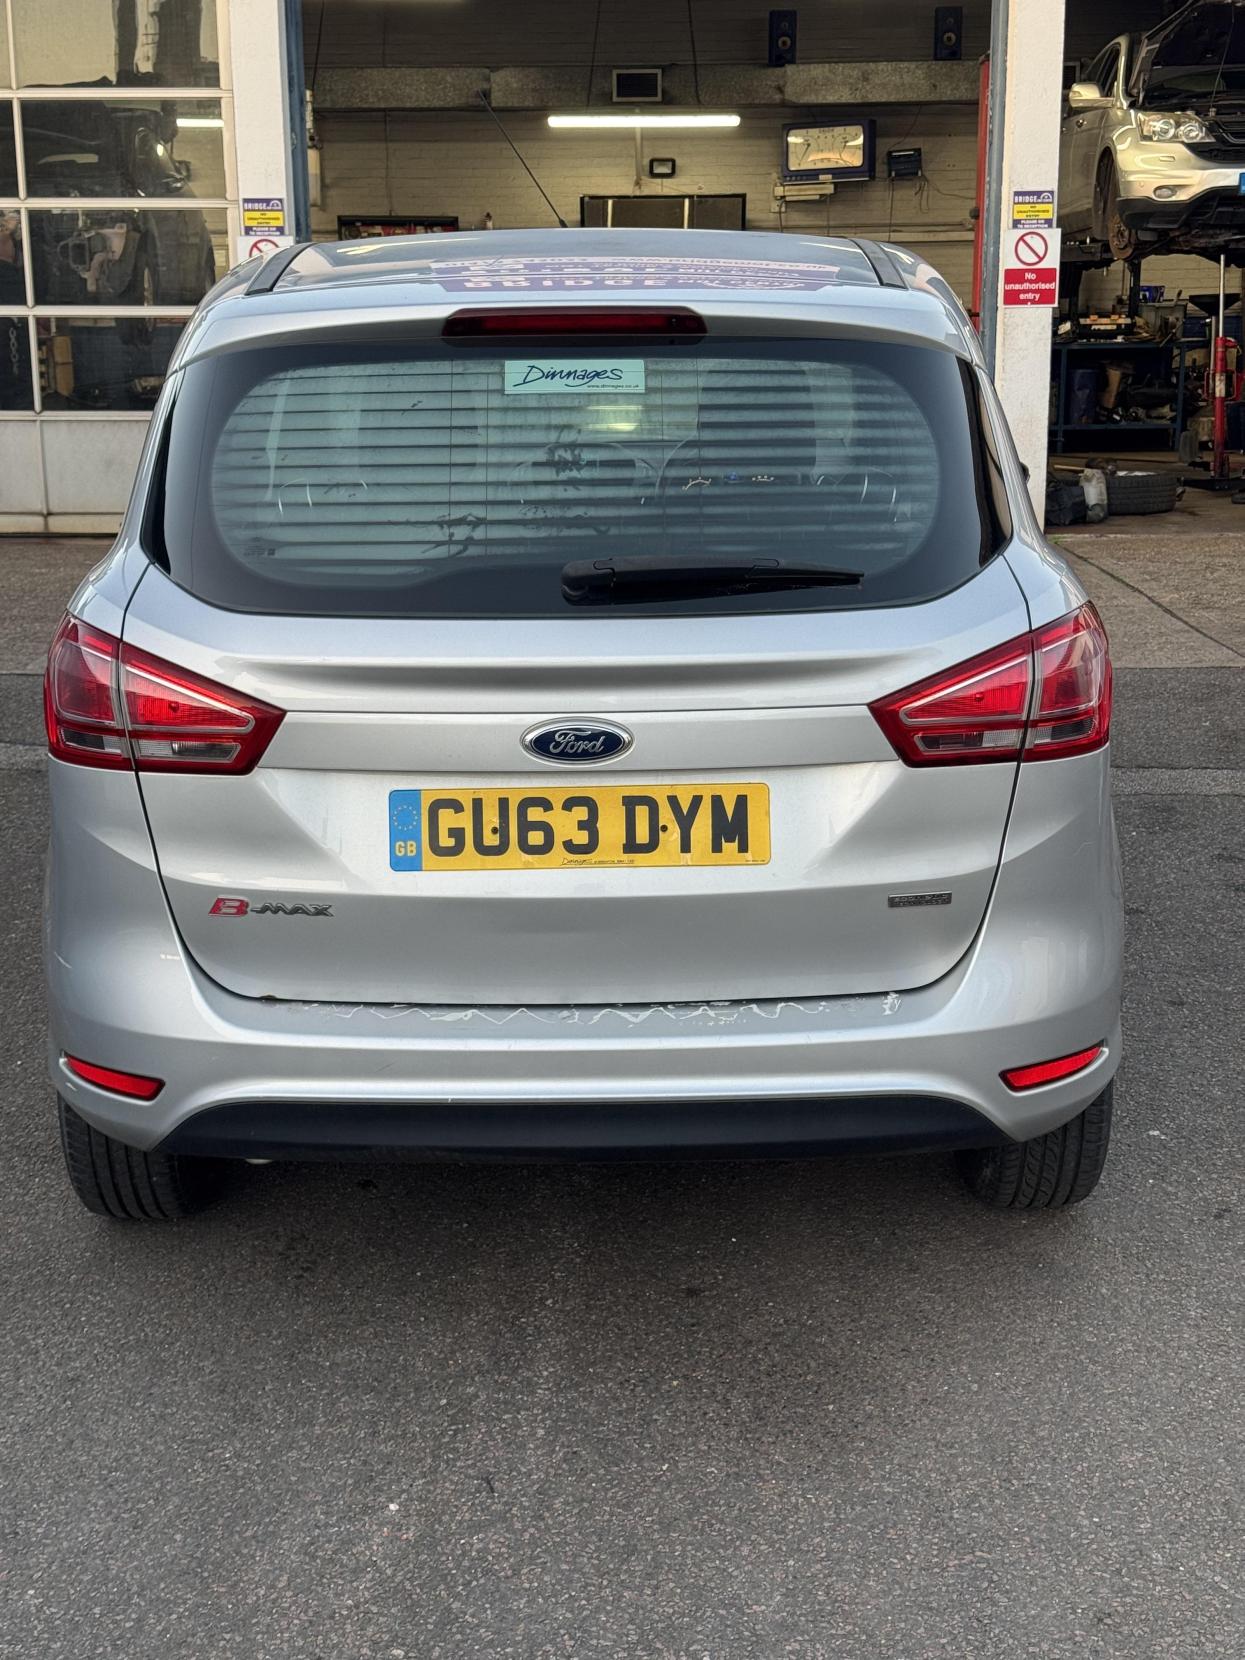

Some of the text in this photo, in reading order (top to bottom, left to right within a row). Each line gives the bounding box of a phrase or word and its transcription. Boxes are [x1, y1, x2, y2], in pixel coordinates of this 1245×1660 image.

[1014, 195, 1038, 203] BRIDGE
[1024, 272, 1037, 280] No
[1005, 282, 1056, 290] unauthorised
[1019, 293, 1041, 301] entry
[512, 365, 624, 387] Dinnages
[549, 730, 606, 753] Ford
[427, 793, 749, 858] GU63 DYM
[395, 841, 417, 857] GB
[208, 896, 334, 917] B-MAX
